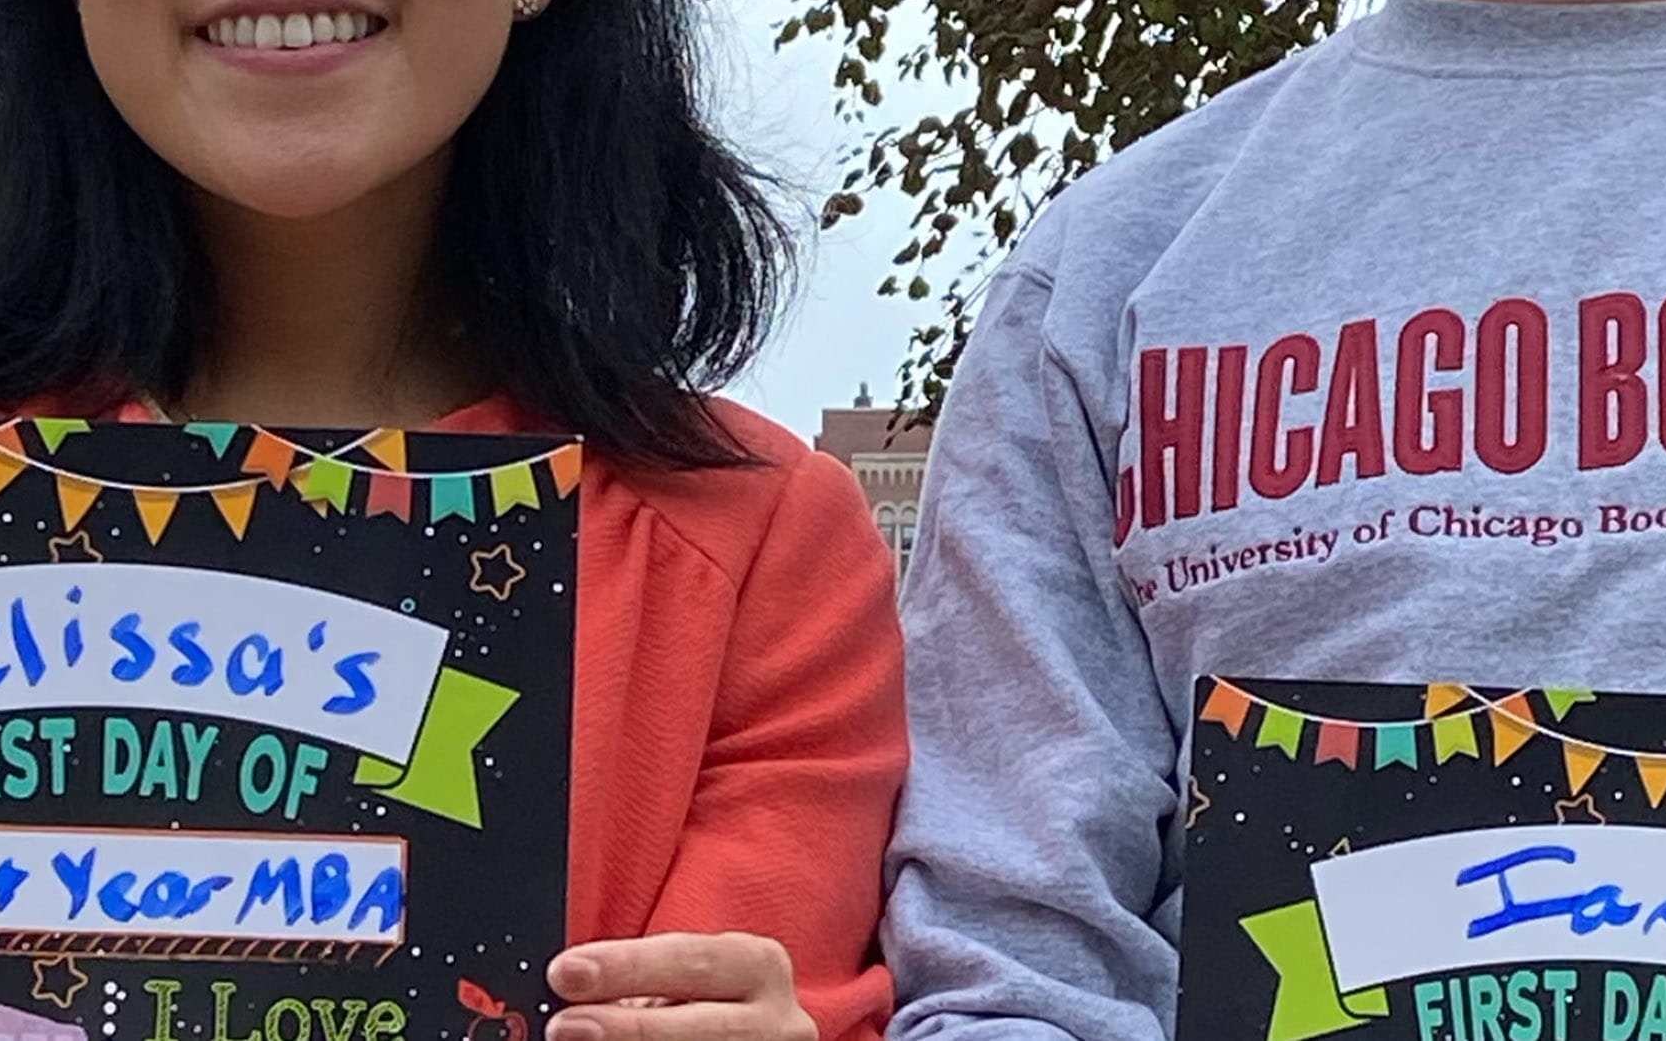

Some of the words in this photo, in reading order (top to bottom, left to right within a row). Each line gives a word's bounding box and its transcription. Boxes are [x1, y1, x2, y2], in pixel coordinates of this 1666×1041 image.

[1113, 298, 1549, 549] HICAGO
[1164, 527, 1339, 593] University
[1353, 510, 1395, 544] of
[1408, 505, 1584, 547] Chicago
[101, 716, 221, 802] DAY
[238, 734, 330, 819] OF
[51, 847, 232, 922] Year
[236, 852, 406, 933] MBA
[143, 979, 182, 1041] I
[210, 981, 406, 1041] Love
[1413, 968, 1579, 1041] FIRST
